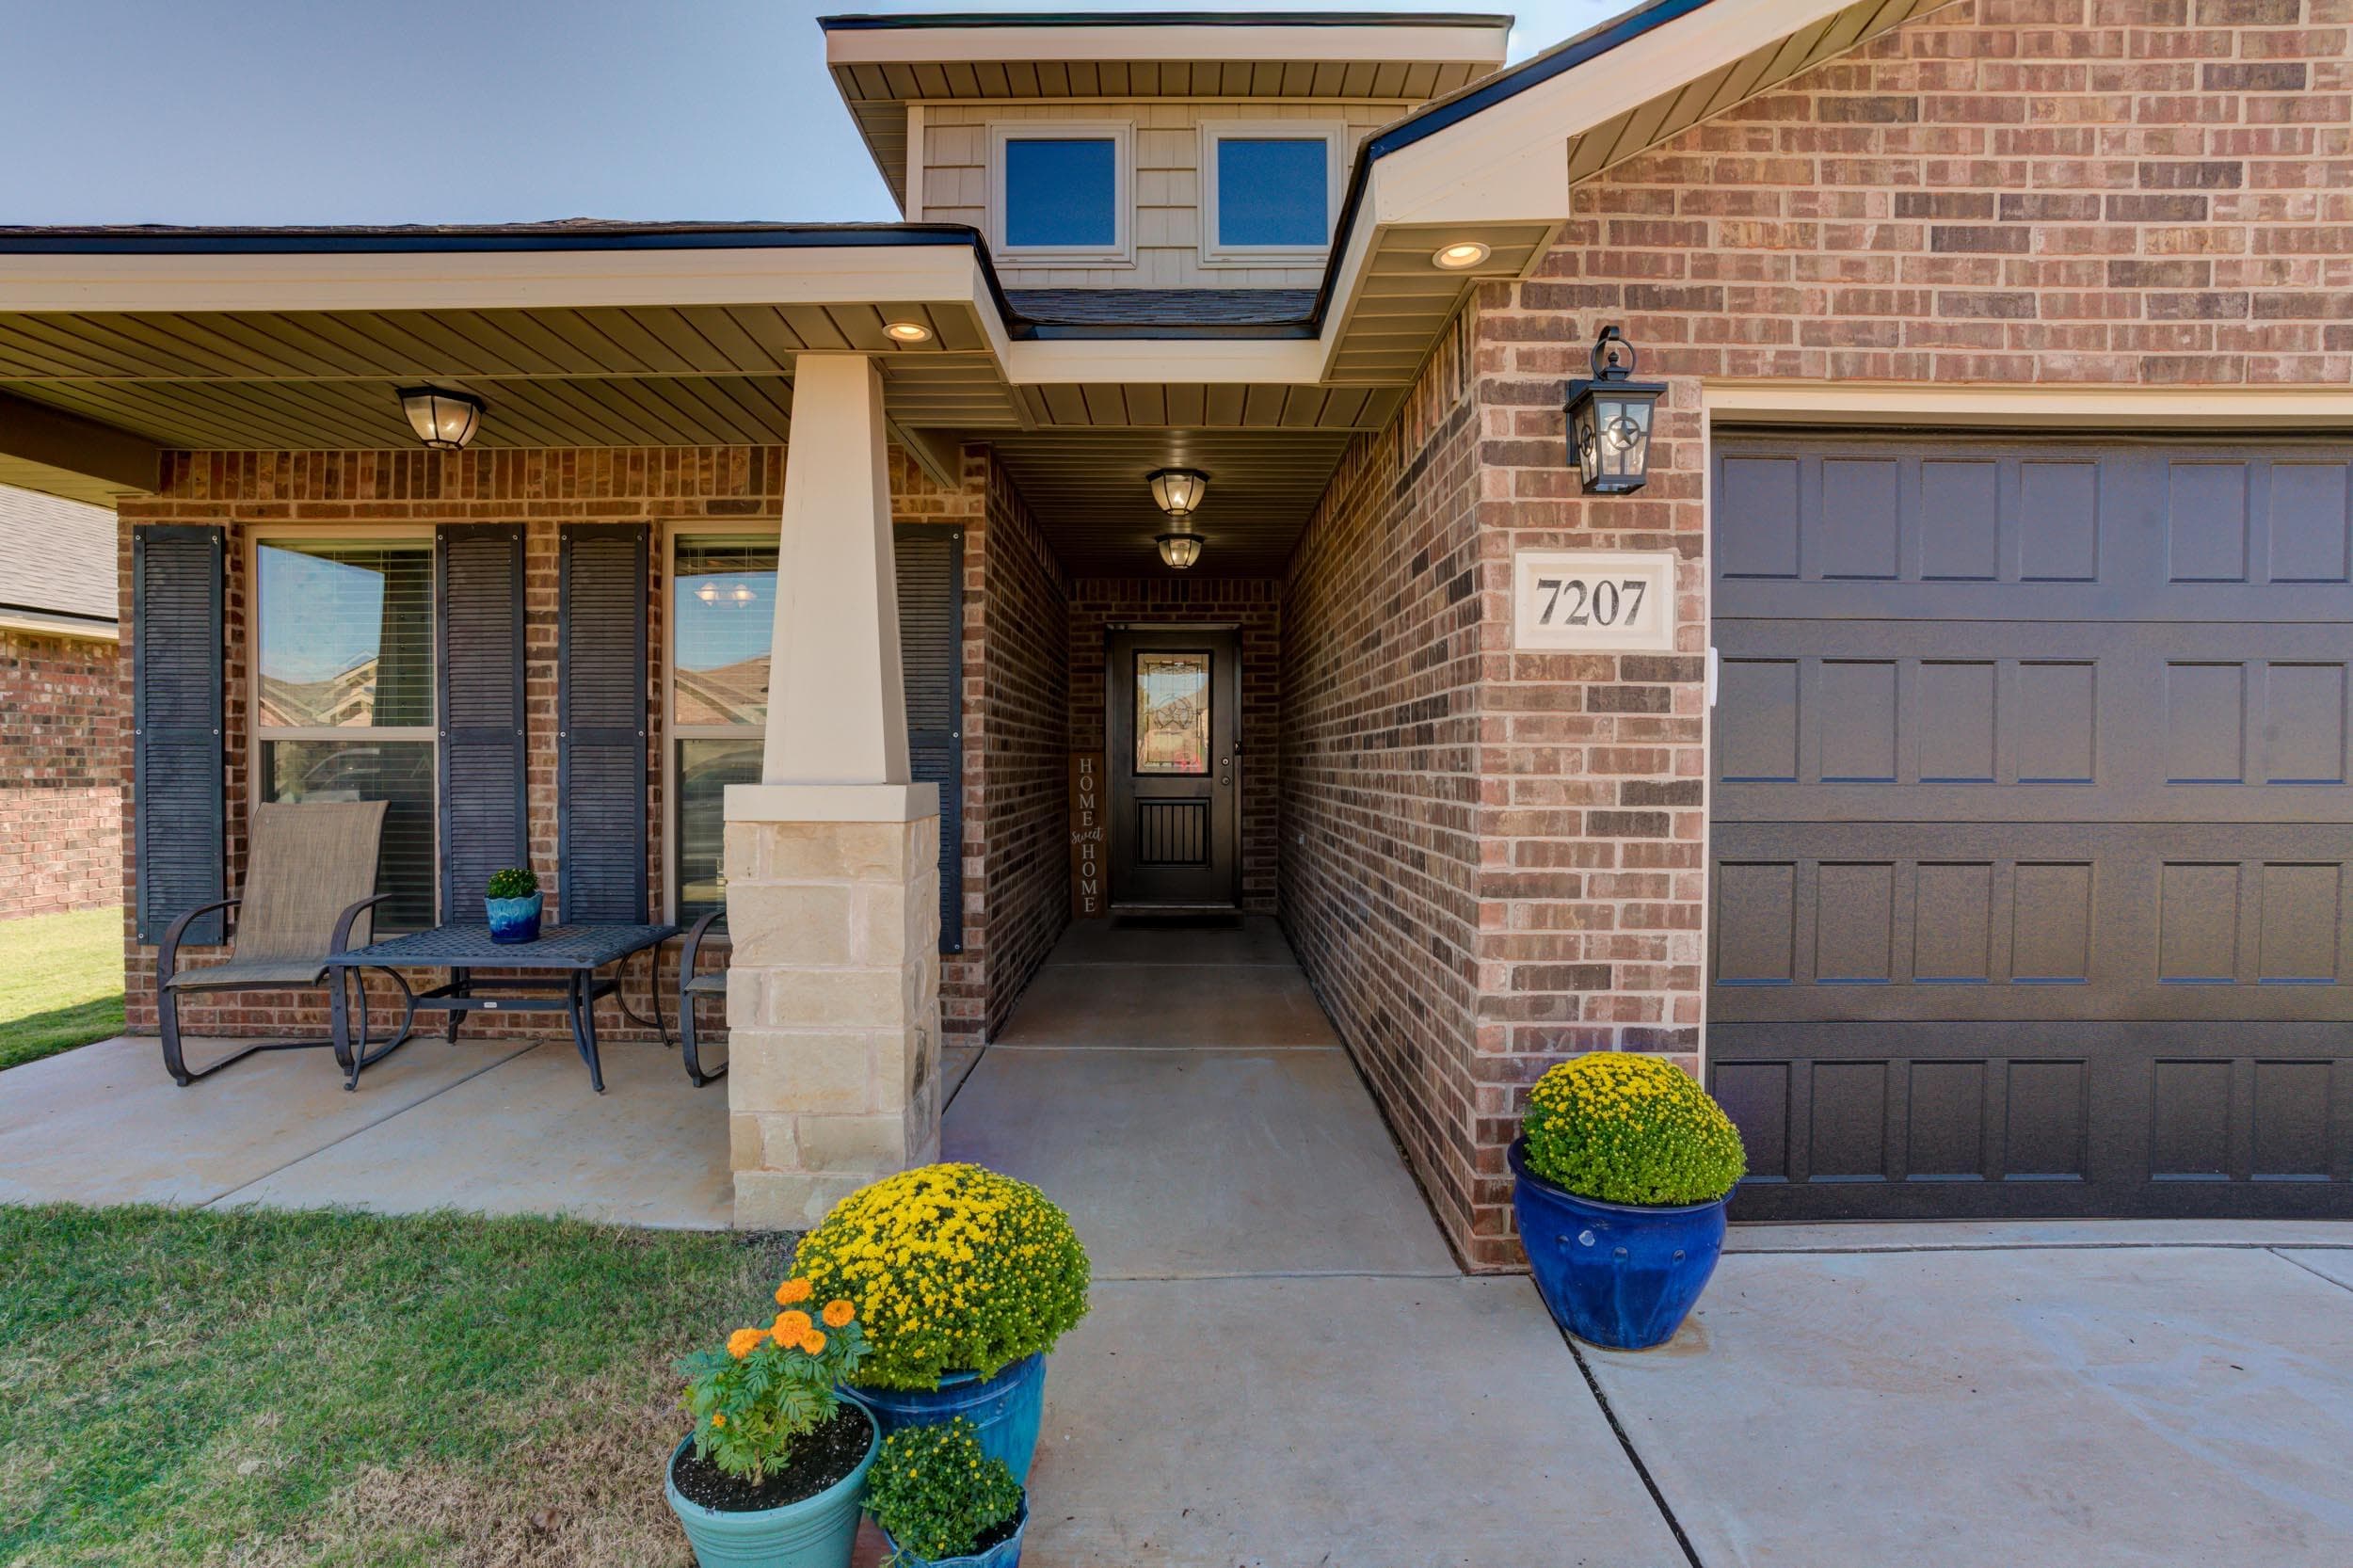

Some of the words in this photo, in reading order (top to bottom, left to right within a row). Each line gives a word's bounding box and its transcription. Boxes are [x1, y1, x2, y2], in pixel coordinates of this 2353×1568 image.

[1536, 578, 1647, 627] 7207
[1079, 758, 1096, 826] HOME
[1071, 826, 1104, 844] sweet
[1081, 843, 1098, 912] HOME
